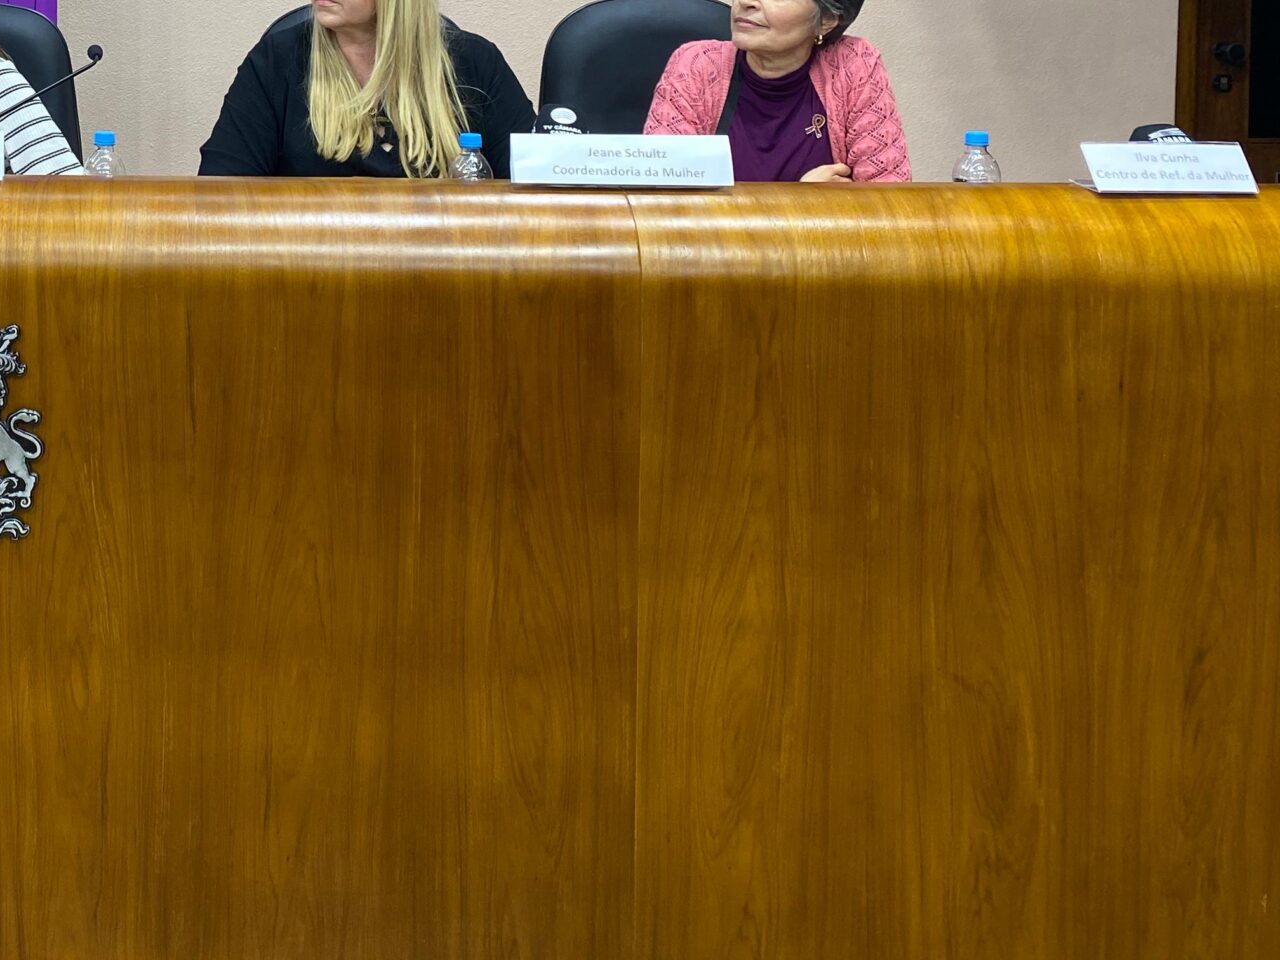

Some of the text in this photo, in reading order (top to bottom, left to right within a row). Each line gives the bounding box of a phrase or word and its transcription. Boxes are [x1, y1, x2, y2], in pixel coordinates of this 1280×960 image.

[588, 147, 668, 159] Jeane Schultz
[1160, 153, 1200, 163] Cunha
[552, 165, 706, 178] Coordenadoria da Mulher
[1095, 169, 1139, 179] Centro
[1142, 169, 1157, 180] de
[1189, 170, 1204, 181] da
[1206, 171, 1250, 181] Mulher
